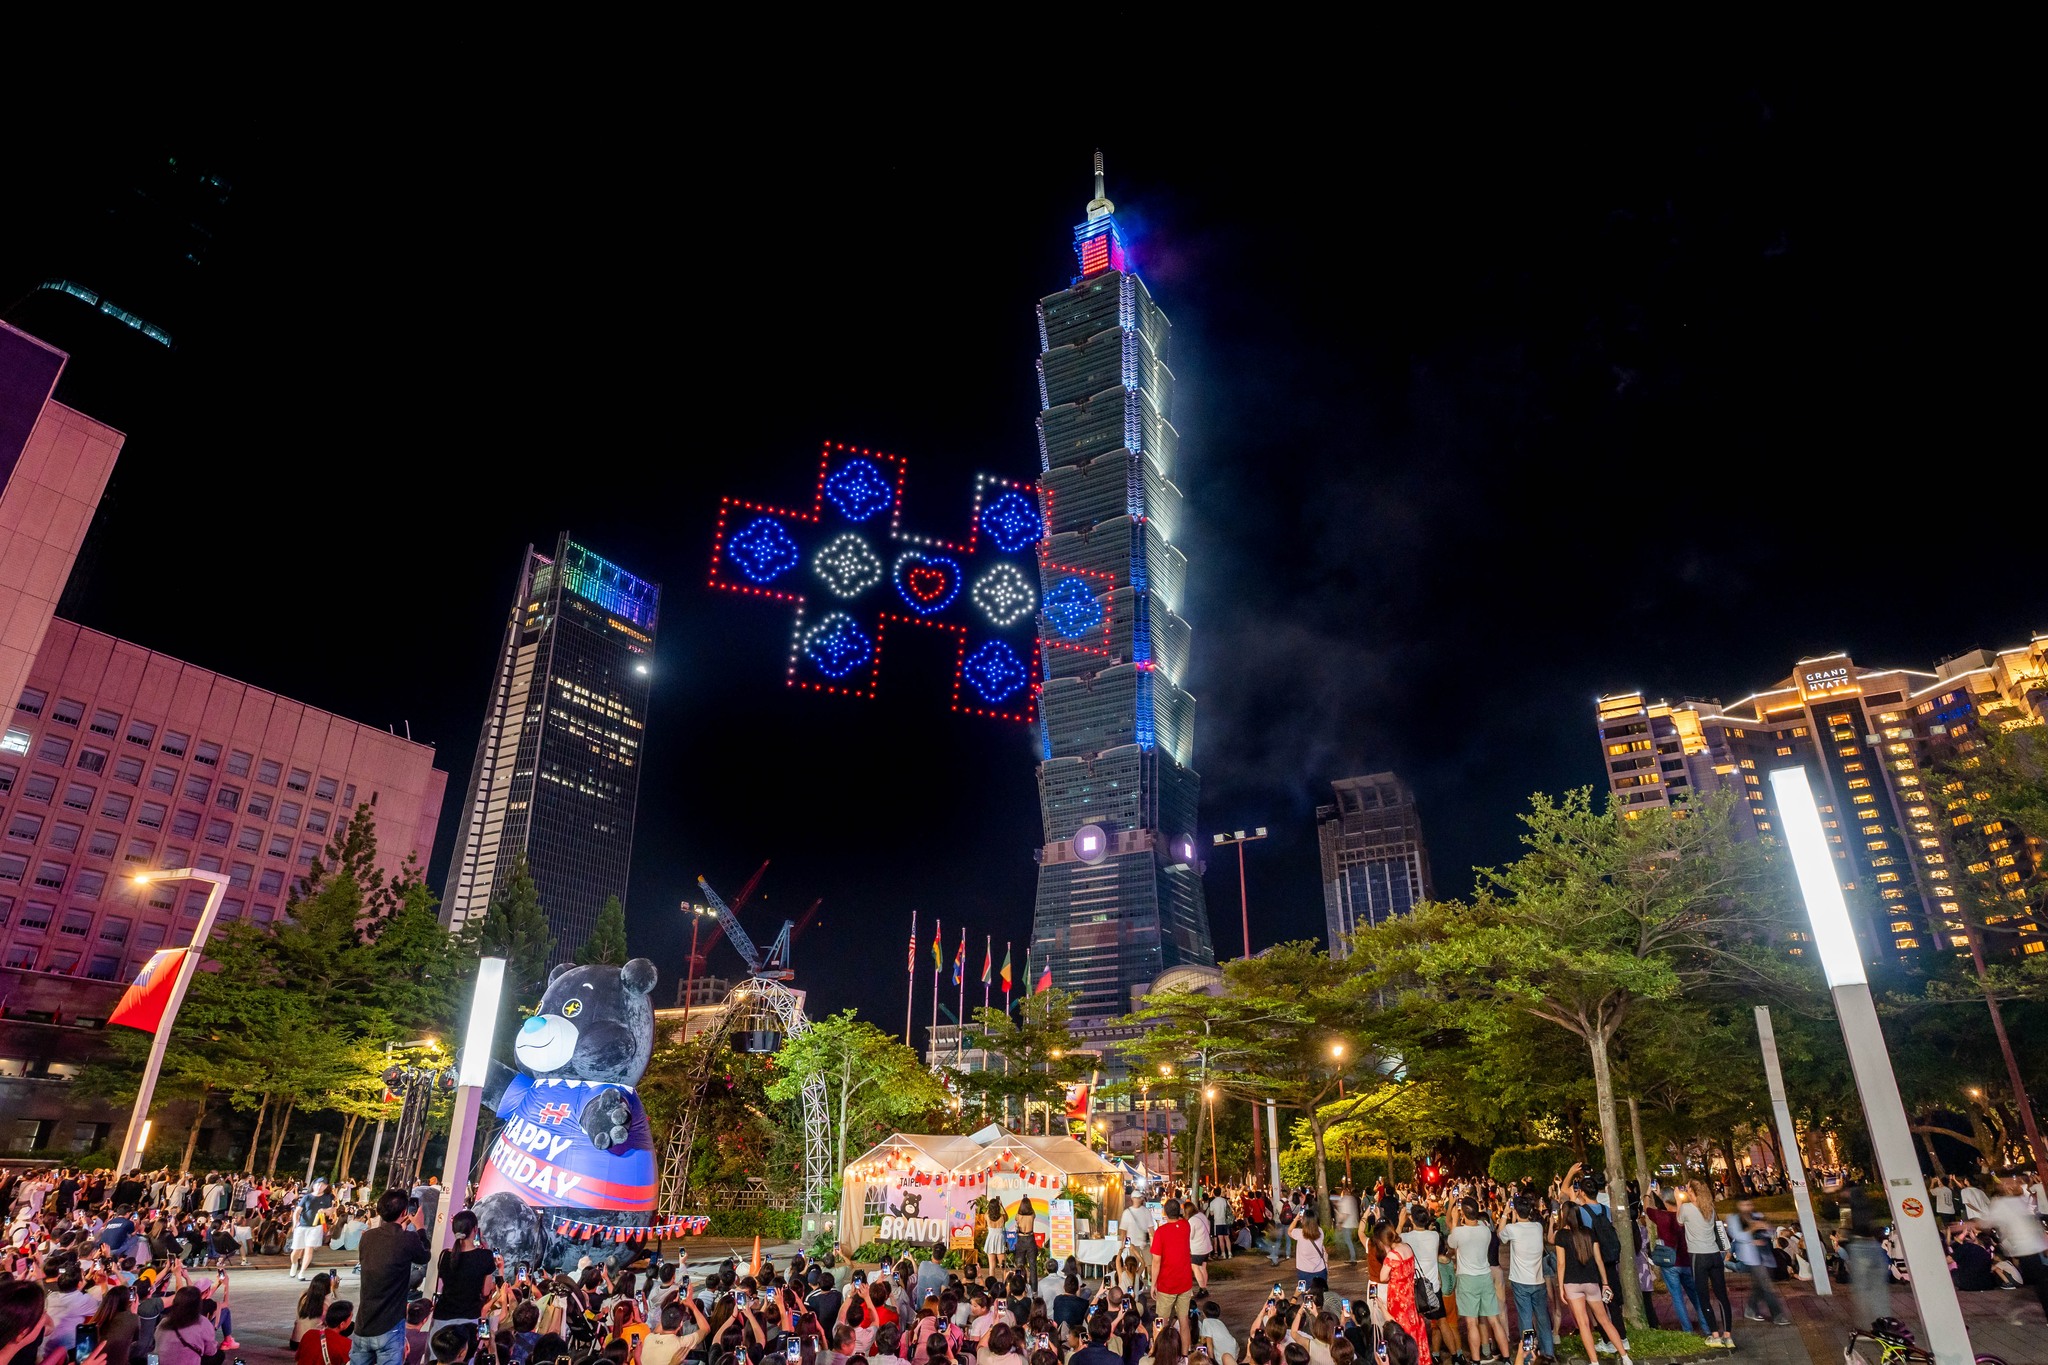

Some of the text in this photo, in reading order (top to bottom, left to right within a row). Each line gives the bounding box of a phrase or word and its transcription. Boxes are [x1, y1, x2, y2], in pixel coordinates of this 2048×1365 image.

[1806, 668, 1847, 681] GRAND
[1810, 678, 1848, 691] HYATT
[503, 1112, 573, 1162] HAPPY
[490, 1134, 582, 1199] IRTHDAY
[880, 1215, 947, 1243] BRAVO!
